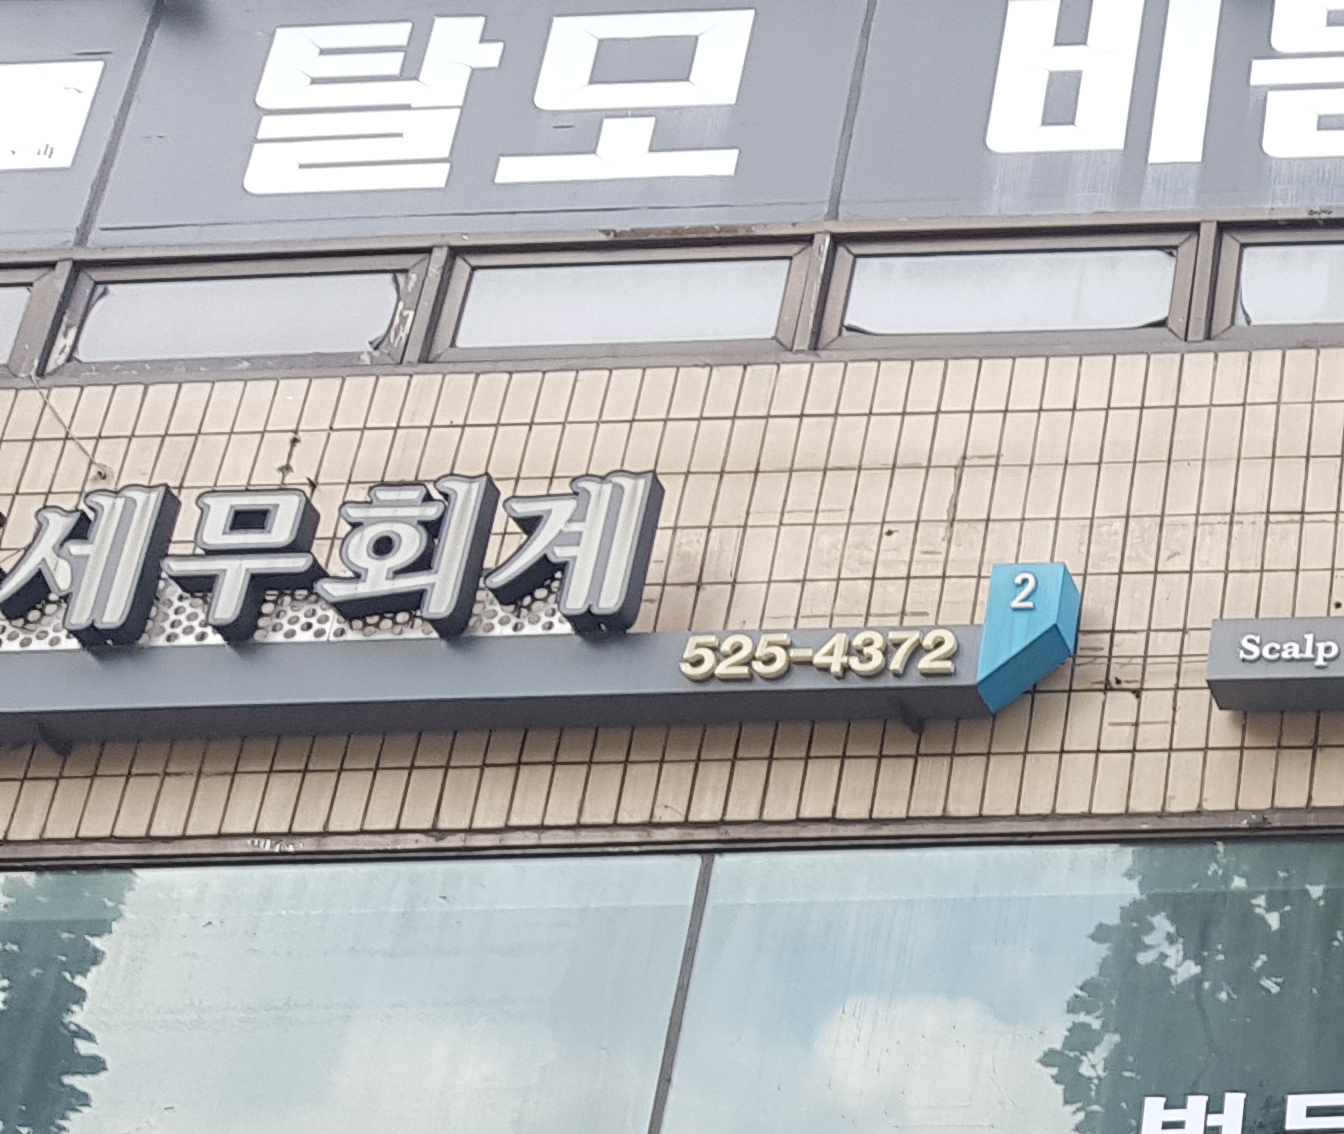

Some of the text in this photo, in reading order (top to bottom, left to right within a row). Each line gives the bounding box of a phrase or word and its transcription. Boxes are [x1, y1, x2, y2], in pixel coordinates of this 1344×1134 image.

[243, 8, 755, 195] 탈모
[0, 470, 662, 648] 세무회계
[1010, 572, 1036, 609] 2
[679, 629, 958, 681] 525-4372
[1238, 633, 1341, 667] Scalp
